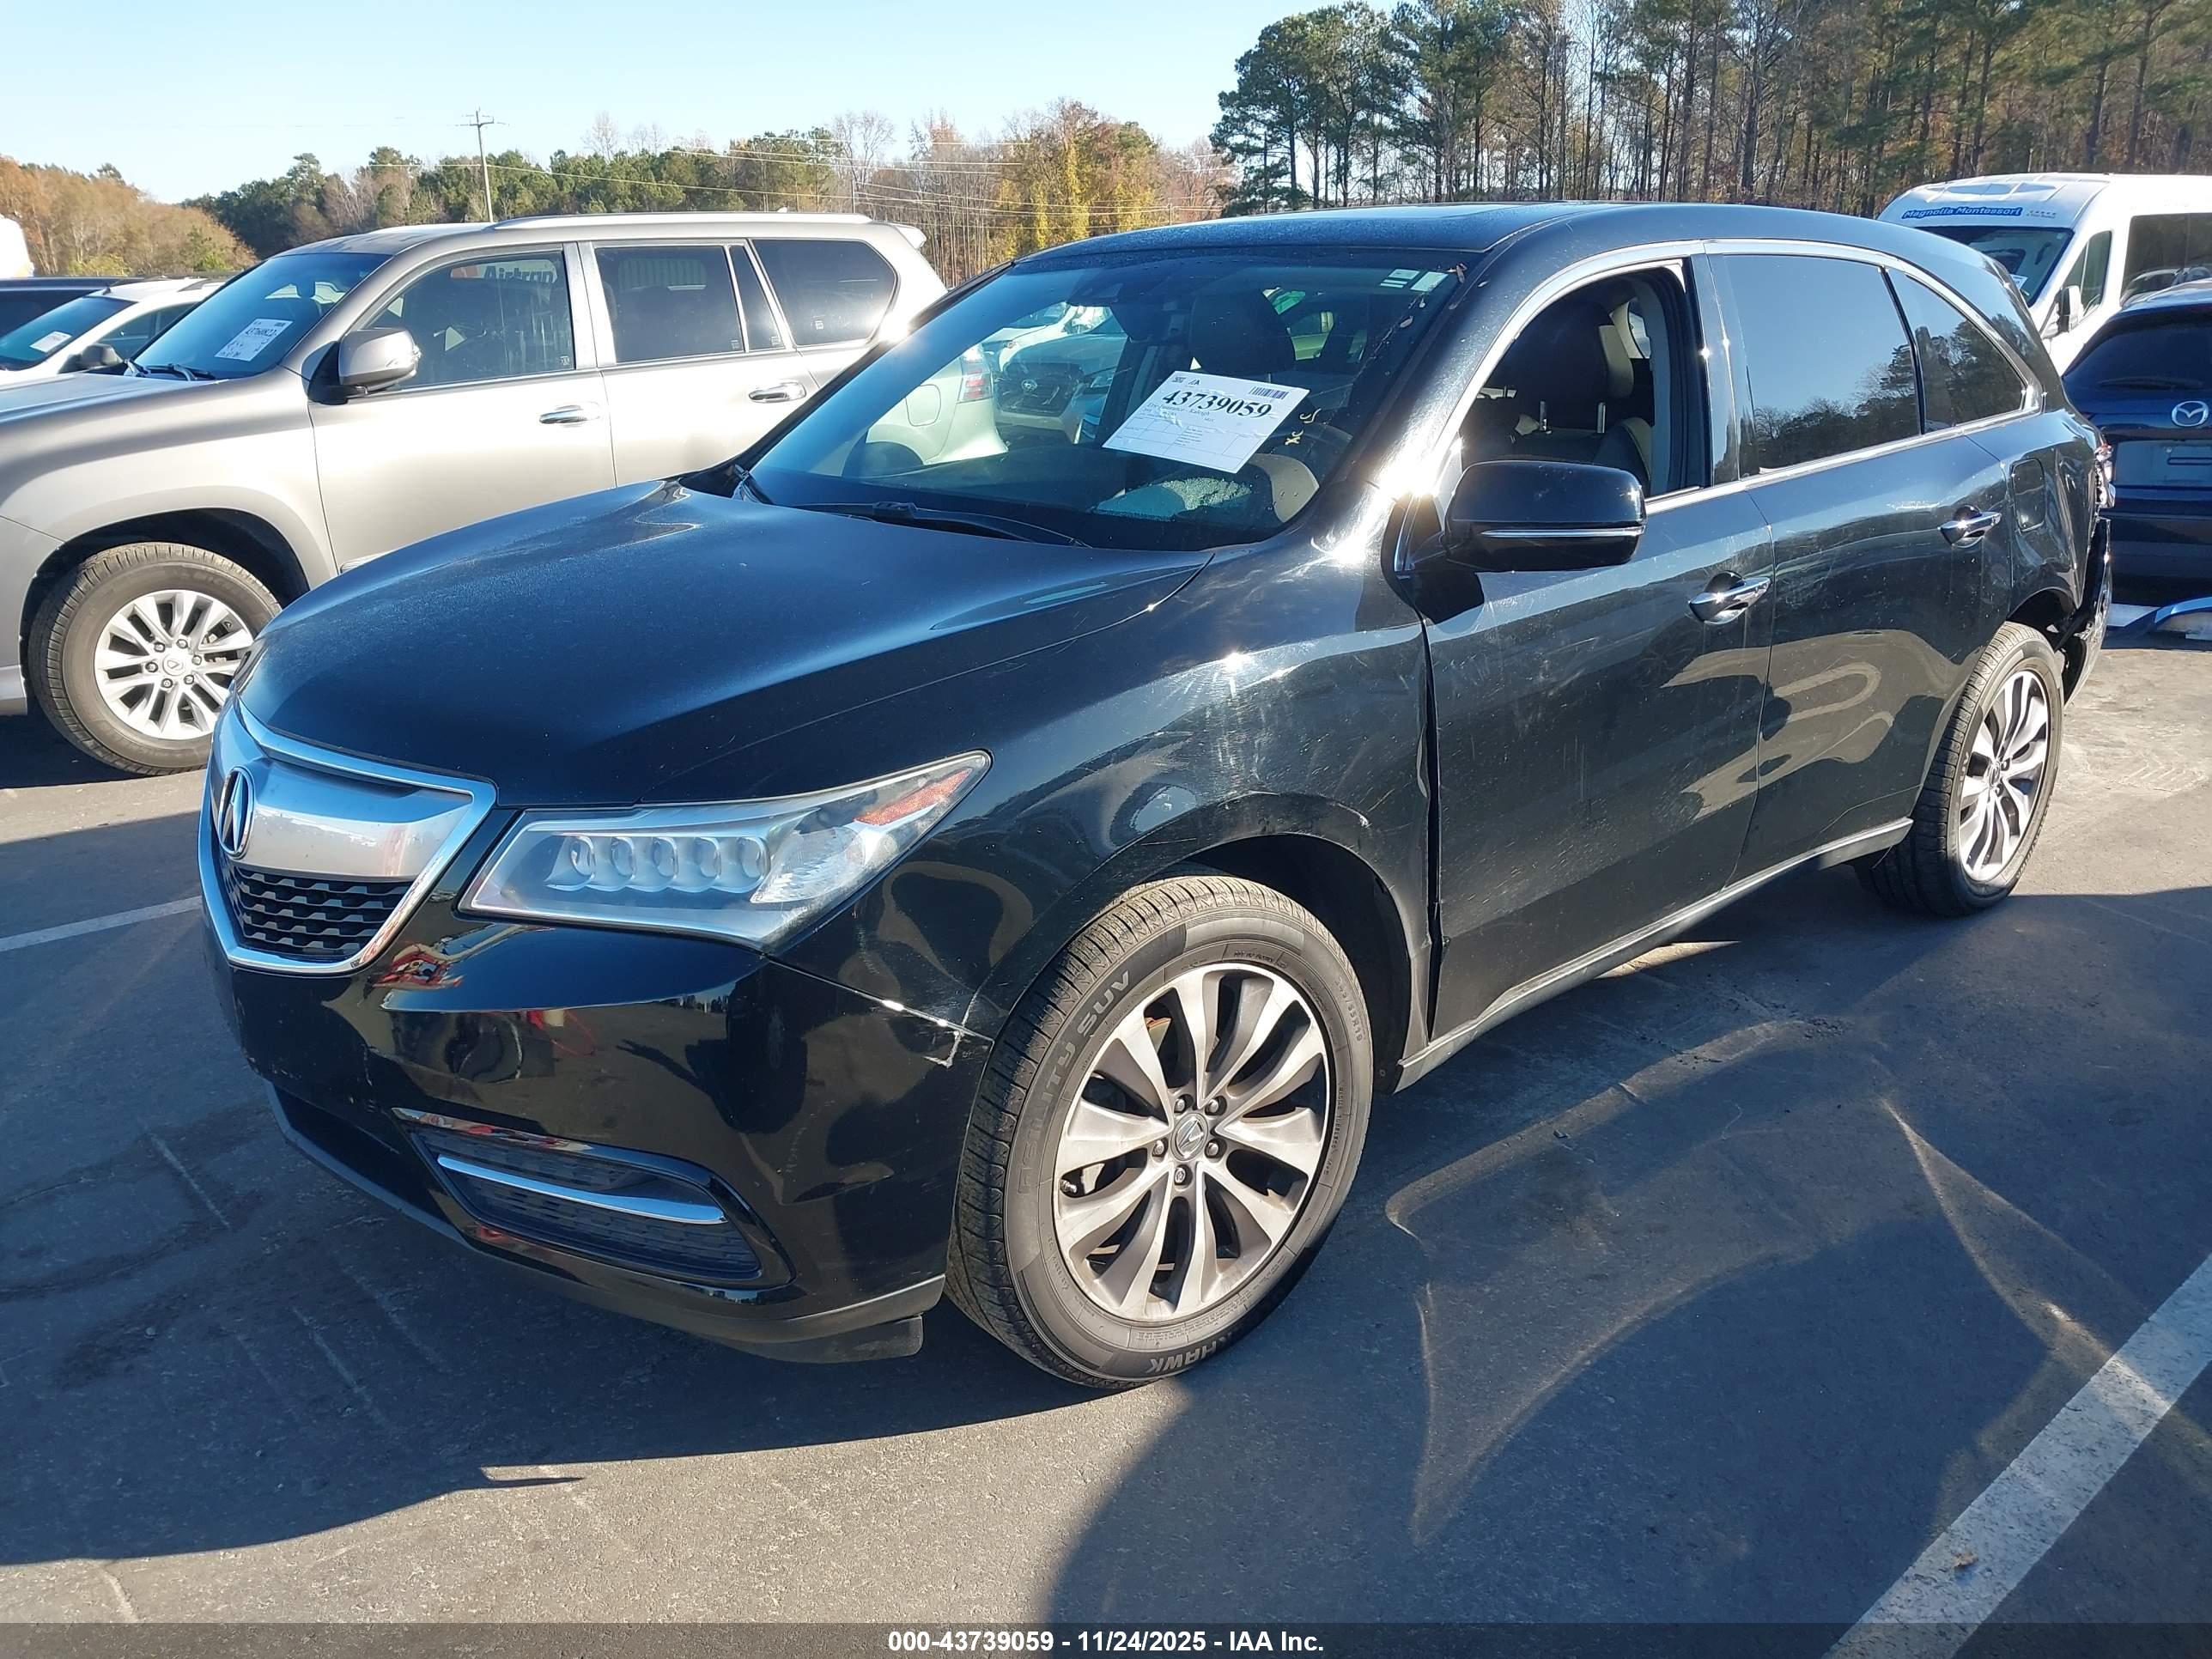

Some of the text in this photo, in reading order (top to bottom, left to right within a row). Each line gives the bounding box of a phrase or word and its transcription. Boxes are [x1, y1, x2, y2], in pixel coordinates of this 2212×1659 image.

[1904, 208, 1954, 218] Magnolia
[1955, 206, 2022, 216] Montessori
[1162, 390, 1273, 418] 43739059
[1077, 969, 1130, 1037] SUV
